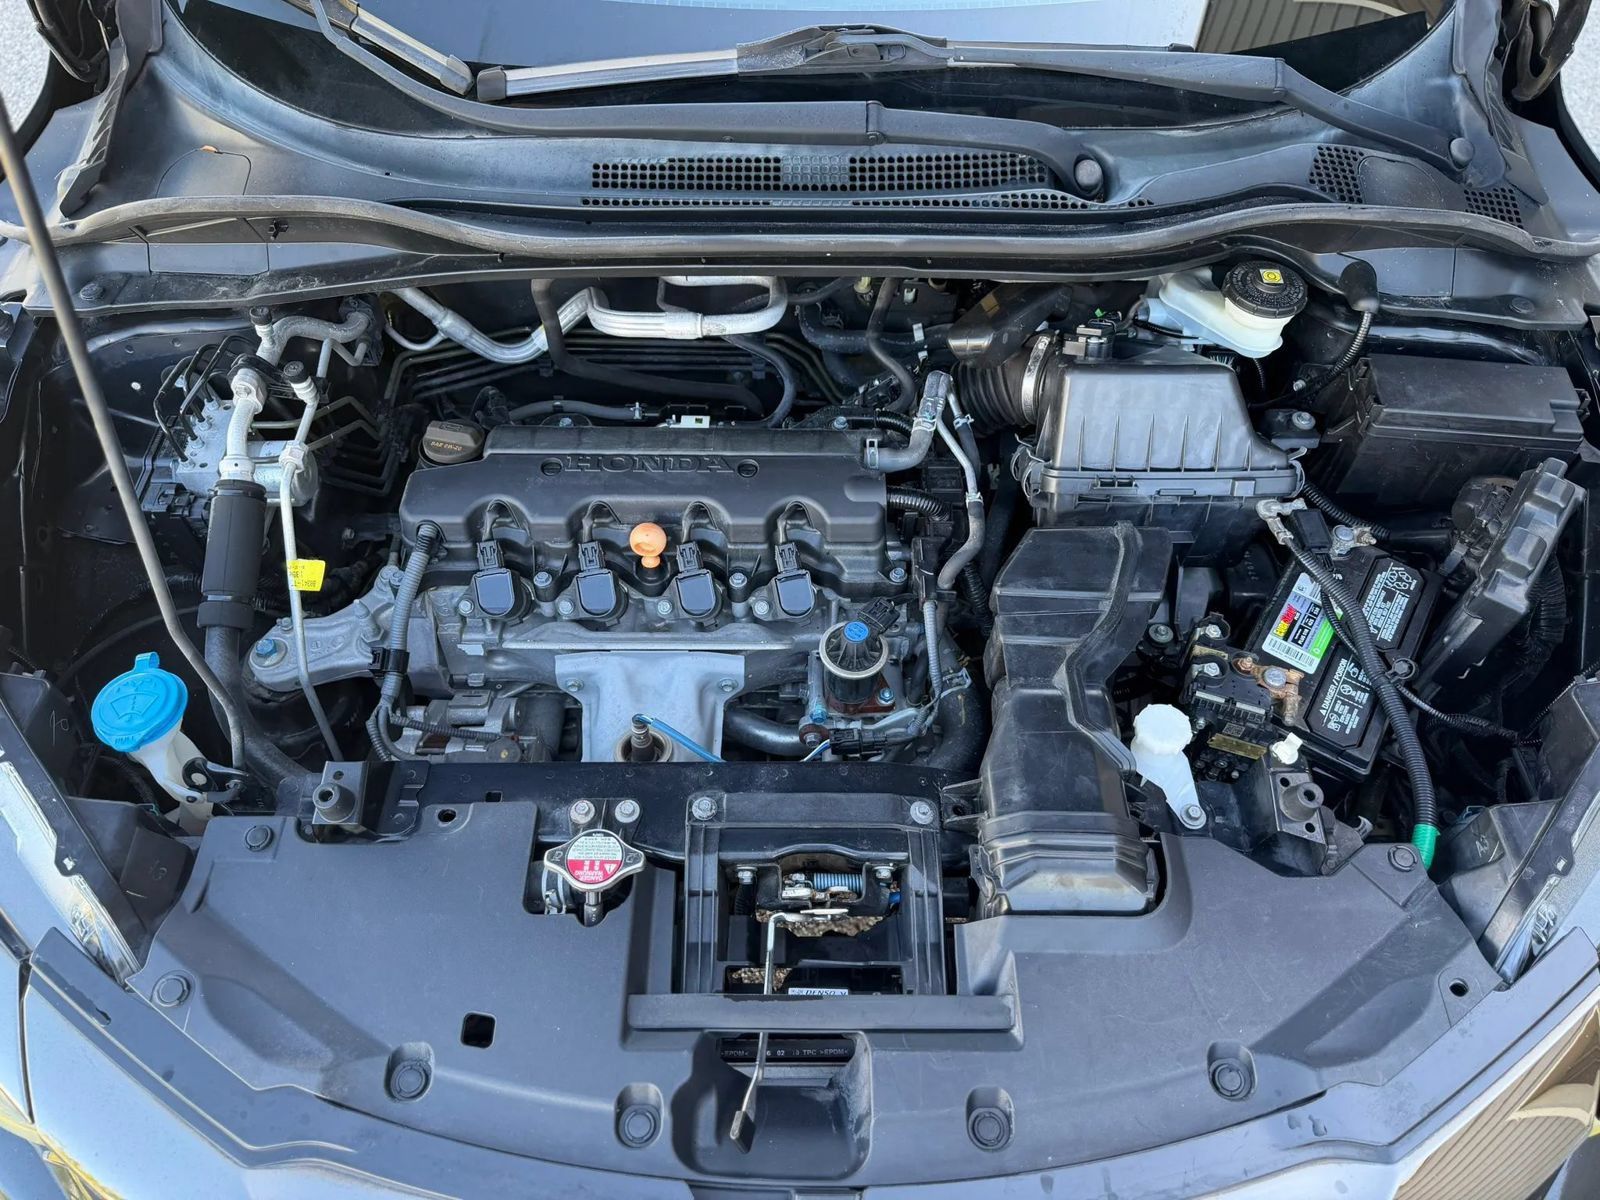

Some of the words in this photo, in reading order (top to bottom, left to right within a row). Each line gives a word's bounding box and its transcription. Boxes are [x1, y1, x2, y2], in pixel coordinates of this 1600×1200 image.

[565, 454, 734, 473] HONDA
[1321, 683, 1337, 709] DANGER
[1333, 657, 1348, 680] POISON
